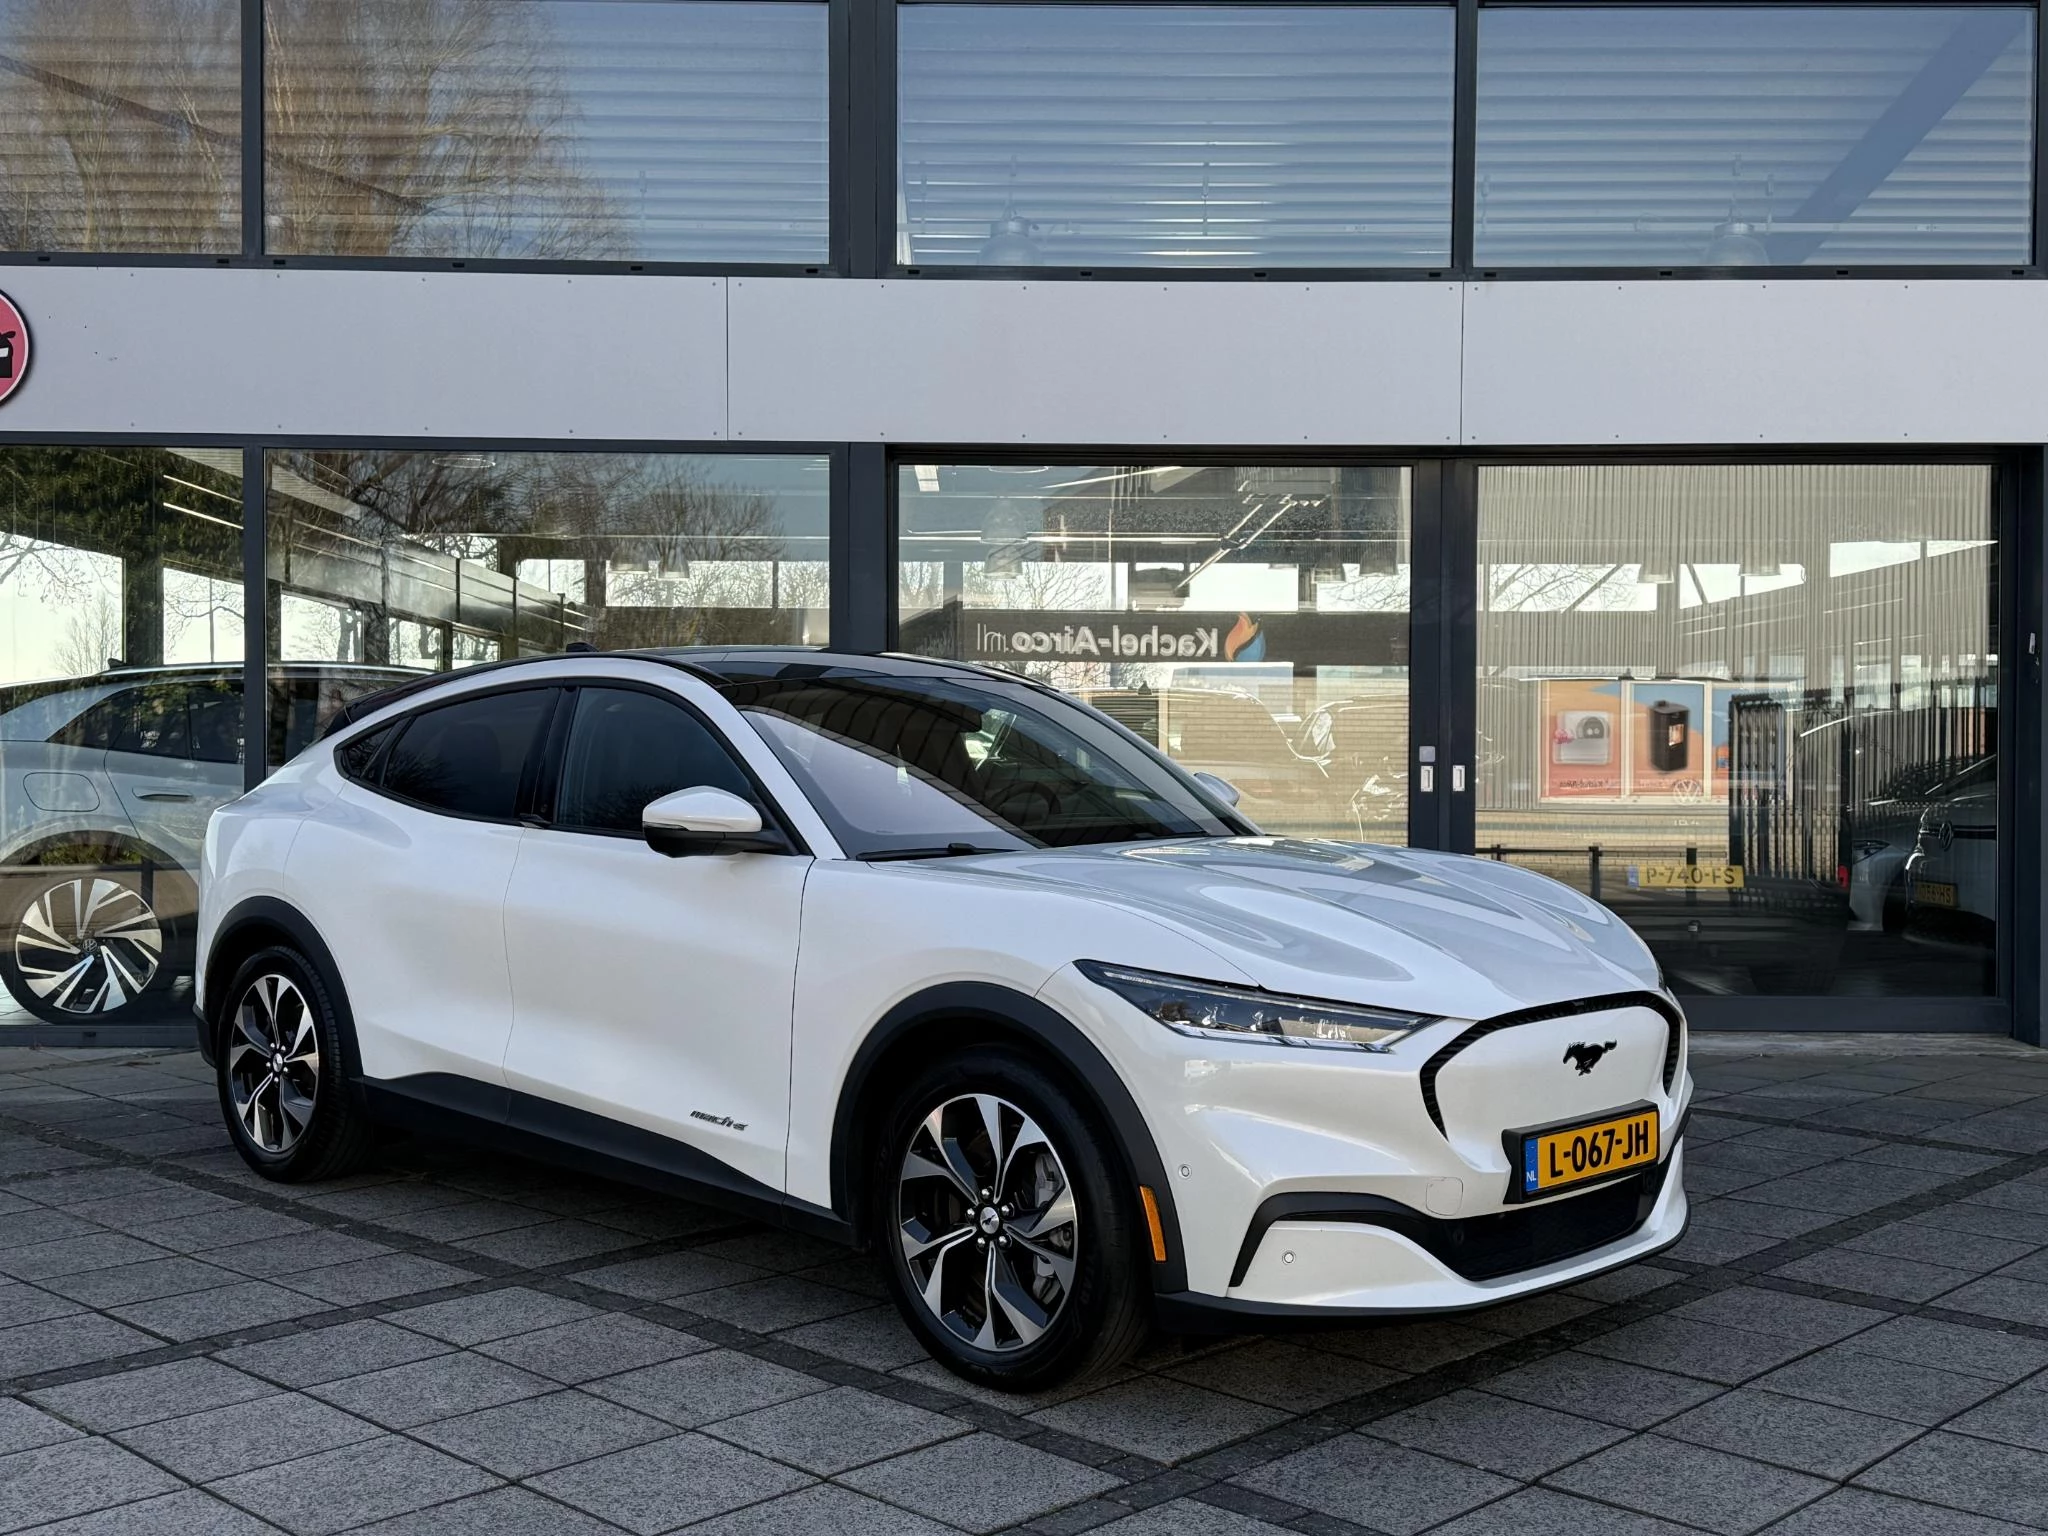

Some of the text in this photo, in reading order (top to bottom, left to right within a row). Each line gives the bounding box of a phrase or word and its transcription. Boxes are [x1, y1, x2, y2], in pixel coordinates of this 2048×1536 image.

[1646, 866, 1735, 885] P-740-FS
[1526, 1120, 1649, 1182] NL L-067-JH
